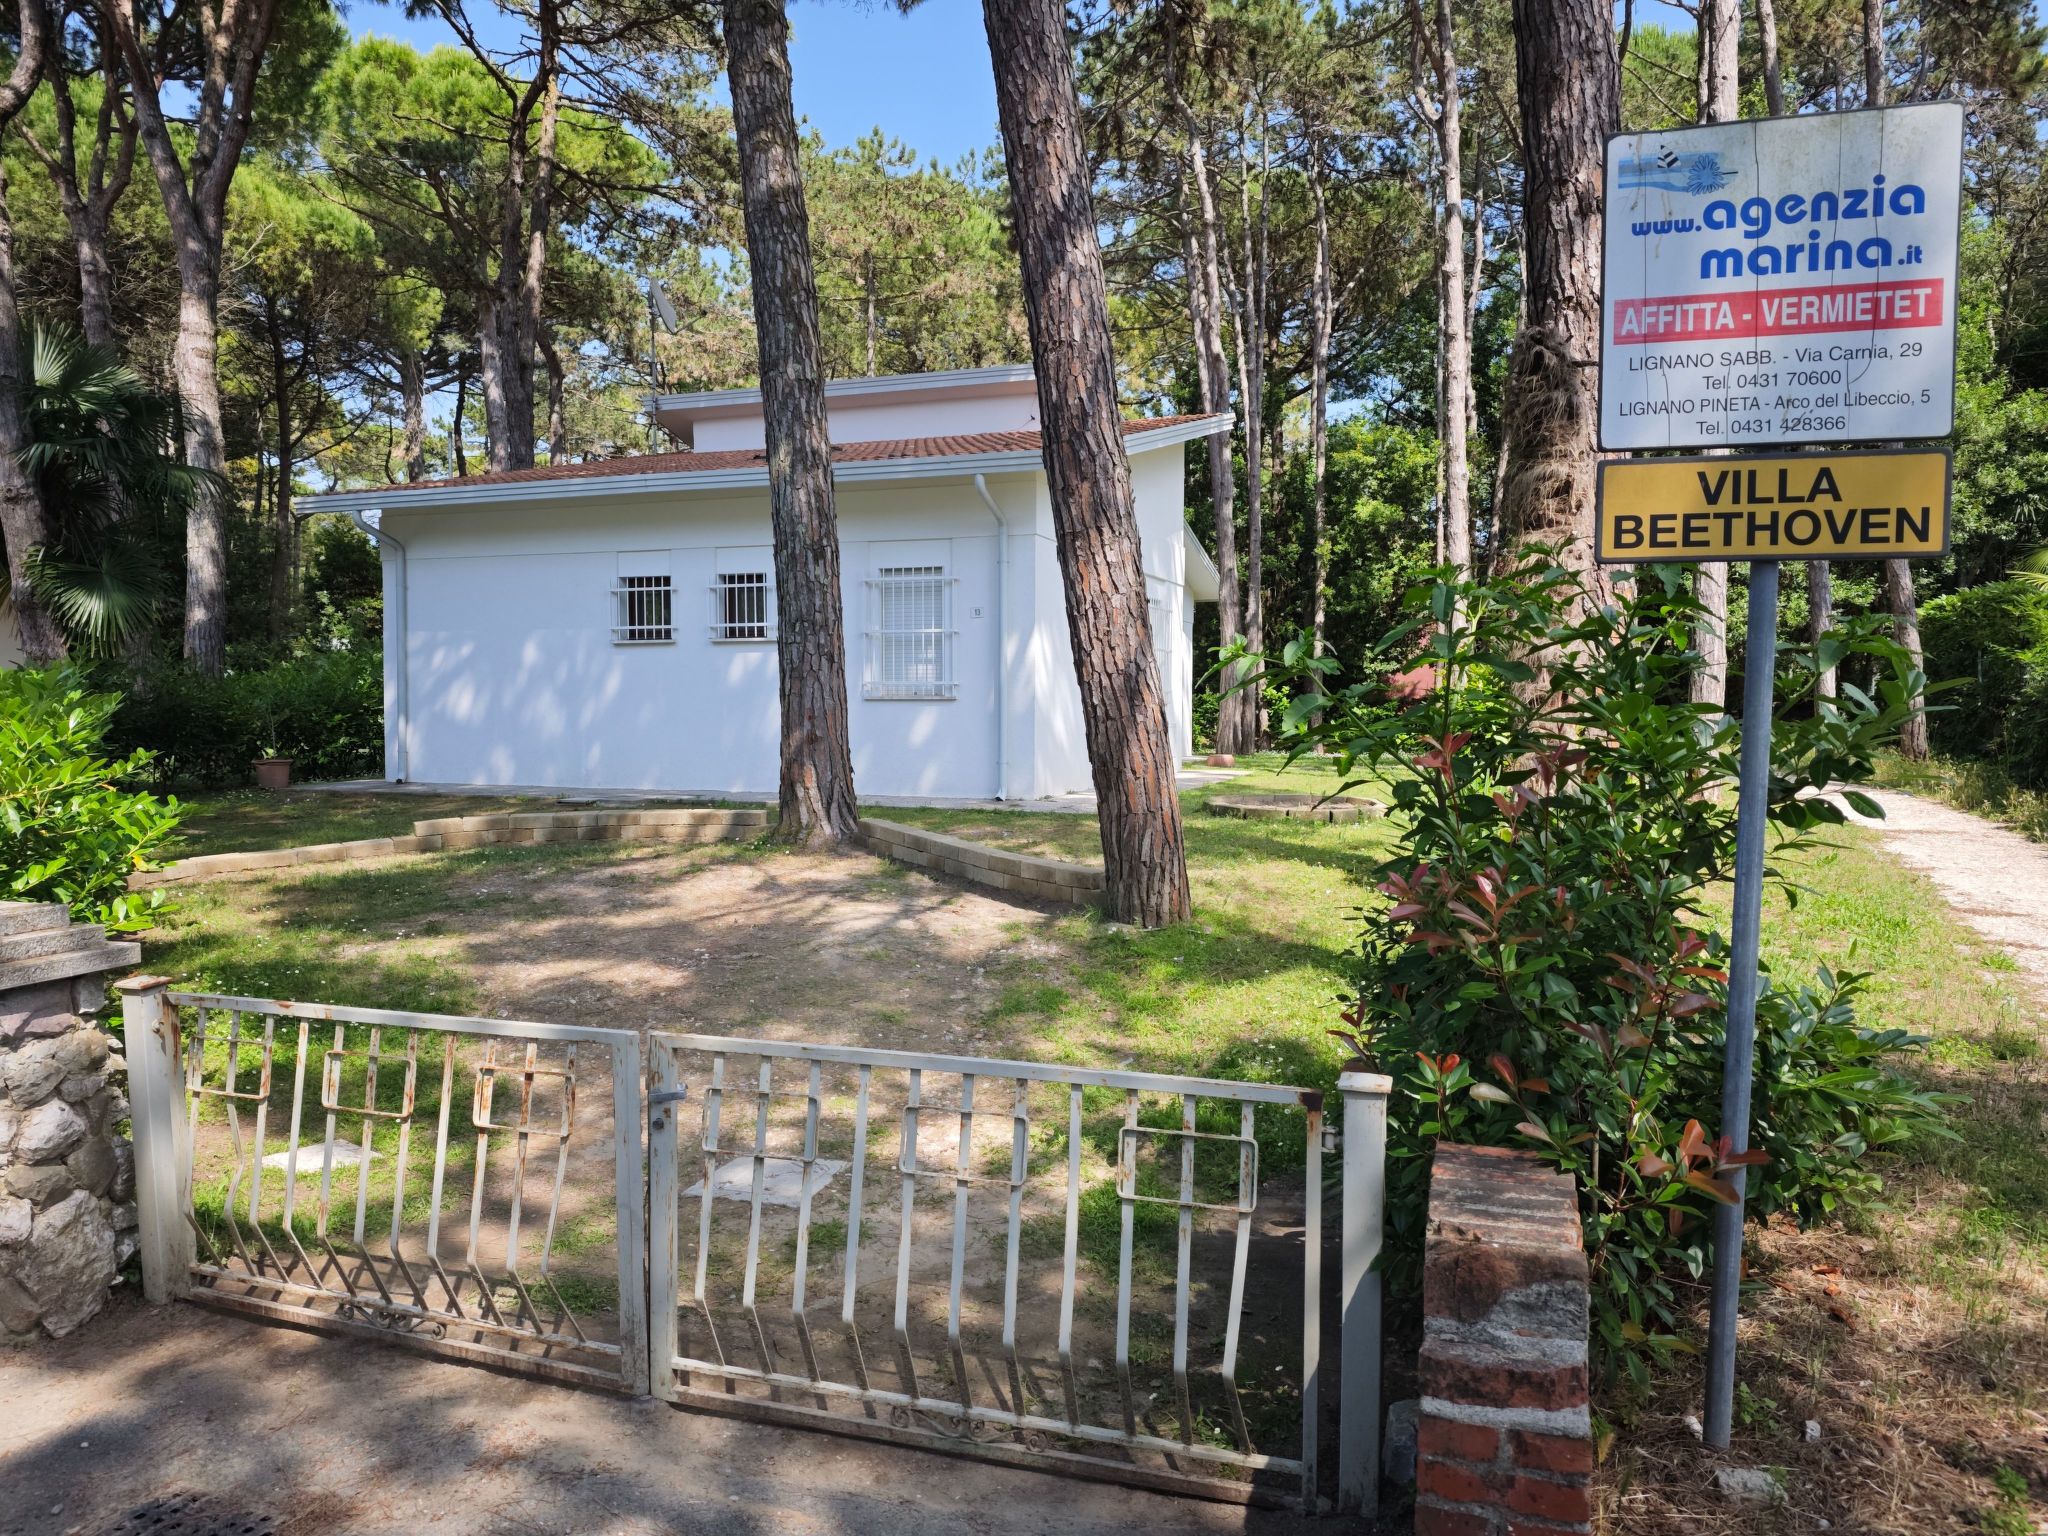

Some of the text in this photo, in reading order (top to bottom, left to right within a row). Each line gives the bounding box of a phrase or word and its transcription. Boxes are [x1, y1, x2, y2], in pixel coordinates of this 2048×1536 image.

[1620, 301, 1735, 337] AFFITTA
[1761, 288, 1932, 328] VERMIETET
[1629, 352, 1714, 372] LIGNANO
[1720, 350, 1777, 367] SABB.
[1795, 346, 1823, 363] Via
[1831, 345, 1893, 361] Carnia,
[1900, 342, 1923, 358] 29
[1702, 370, 1842, 390] Tel. 0431 70600
[1619, 399, 1695, 416] LIGNANO
[1700, 396, 1760, 413] PINETA
[1775, 394, 1810, 410] Arco
[1815, 393, 1839, 408] del
[1844, 391, 1915, 407] Libeccio,
[1921, 388, 1931, 404] 5
[1696, 416, 1846, 435] Tel. 0431 428366
[1697, 467, 1842, 506] VILLA
[1613, 506, 1931, 549] BEETHOVEN
